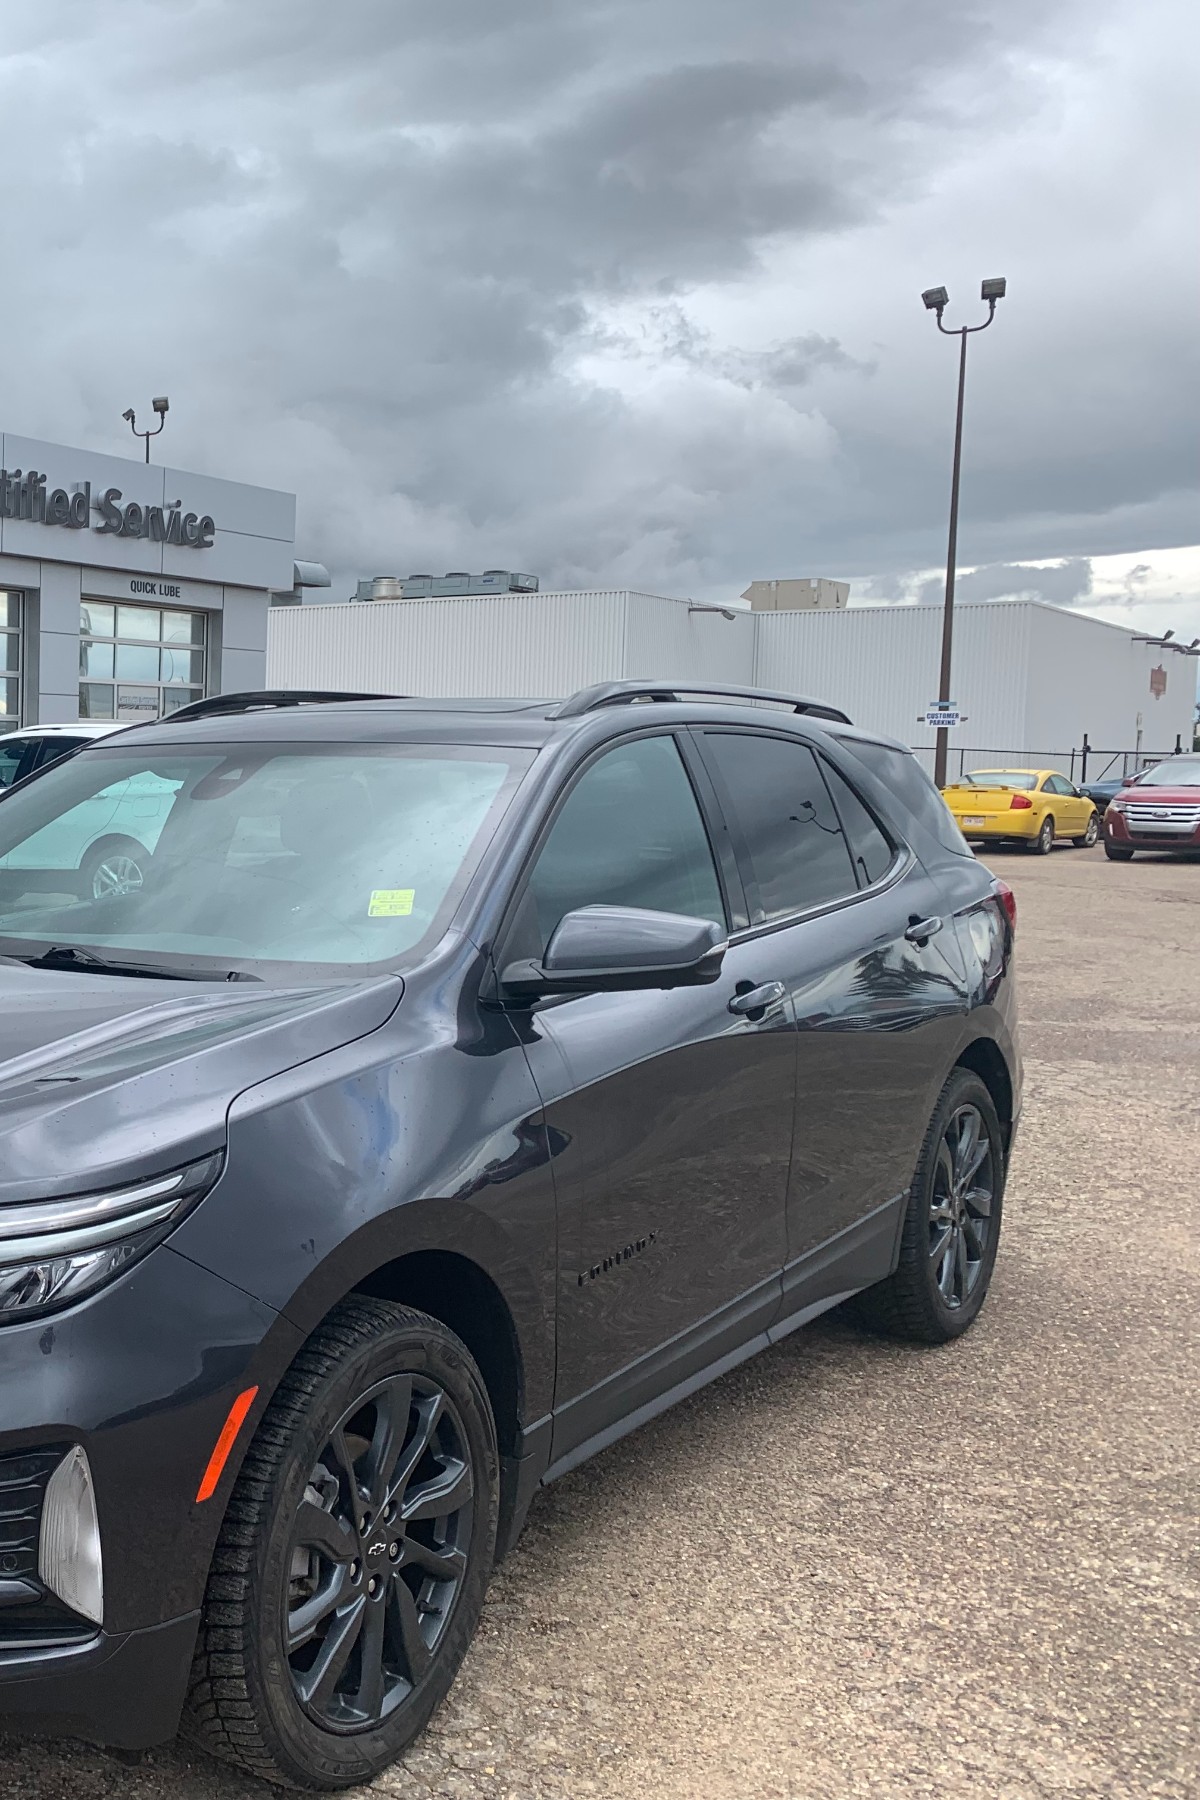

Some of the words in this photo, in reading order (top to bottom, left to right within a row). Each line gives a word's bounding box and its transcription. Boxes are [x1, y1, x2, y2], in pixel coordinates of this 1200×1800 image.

[97, 487, 216, 549] Service
[130, 580, 157, 595] QUICK
[159, 584, 181, 598] LUBE
[926, 712, 960, 720] CUSTOMER
